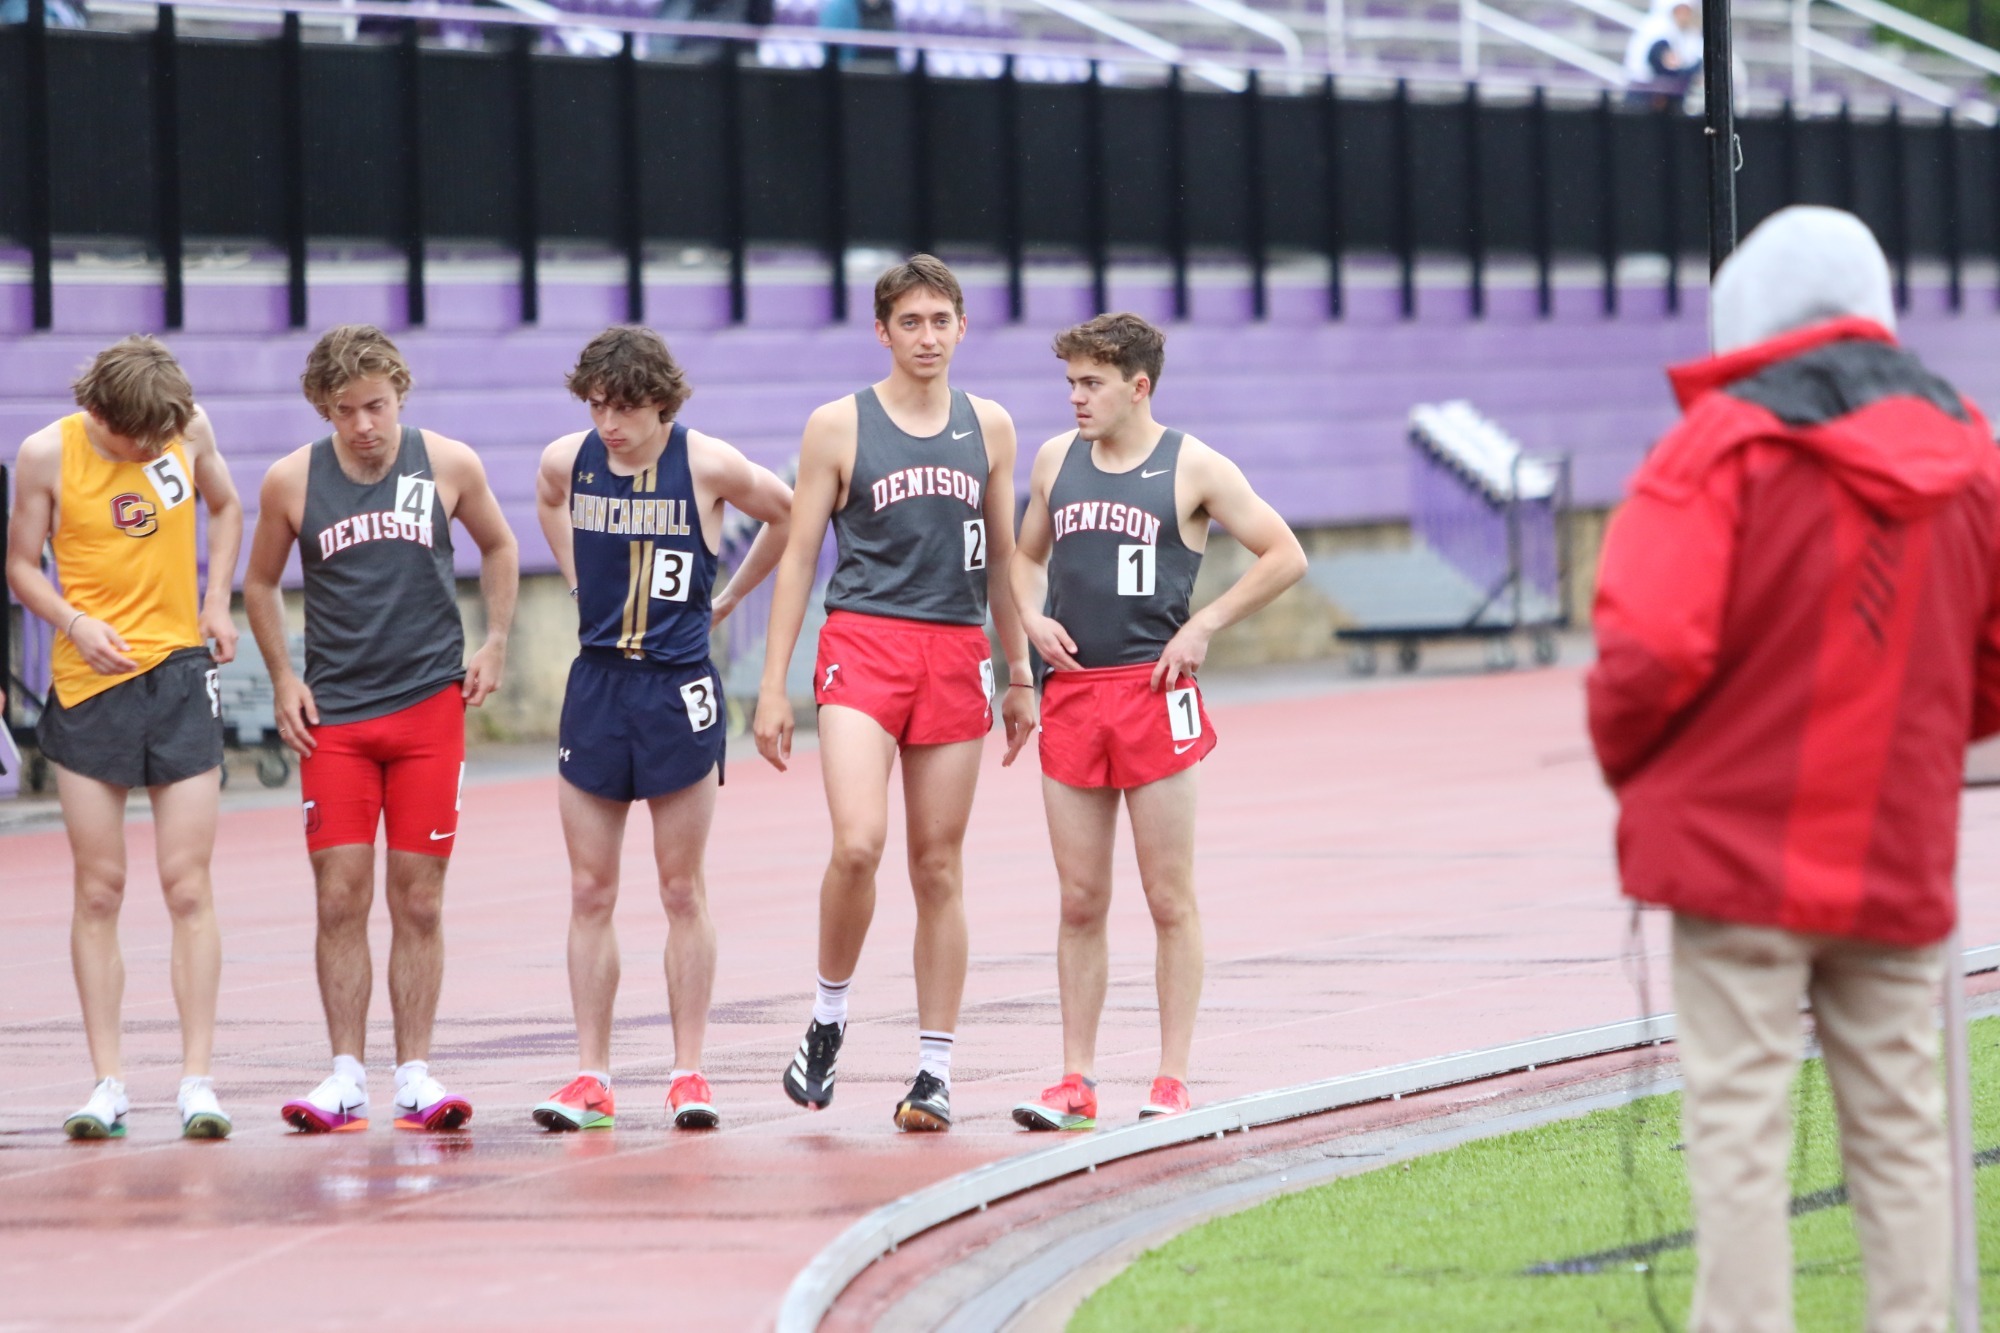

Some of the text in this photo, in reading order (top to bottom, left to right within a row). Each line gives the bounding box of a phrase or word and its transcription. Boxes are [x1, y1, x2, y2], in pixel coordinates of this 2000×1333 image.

[152, 458, 184, 504] 5
[401, 481, 426, 523] 4
[871, 466, 980, 512] DENISON
[608, 497, 690, 535] CARROLL
[1053, 501, 1161, 546] DENISON
[969, 522, 982, 568] 2
[659, 553, 684, 598] 3
[1128, 548, 1144, 593] 1
[689, 684, 712, 727] 3
[1178, 692, 1194, 736] 1
